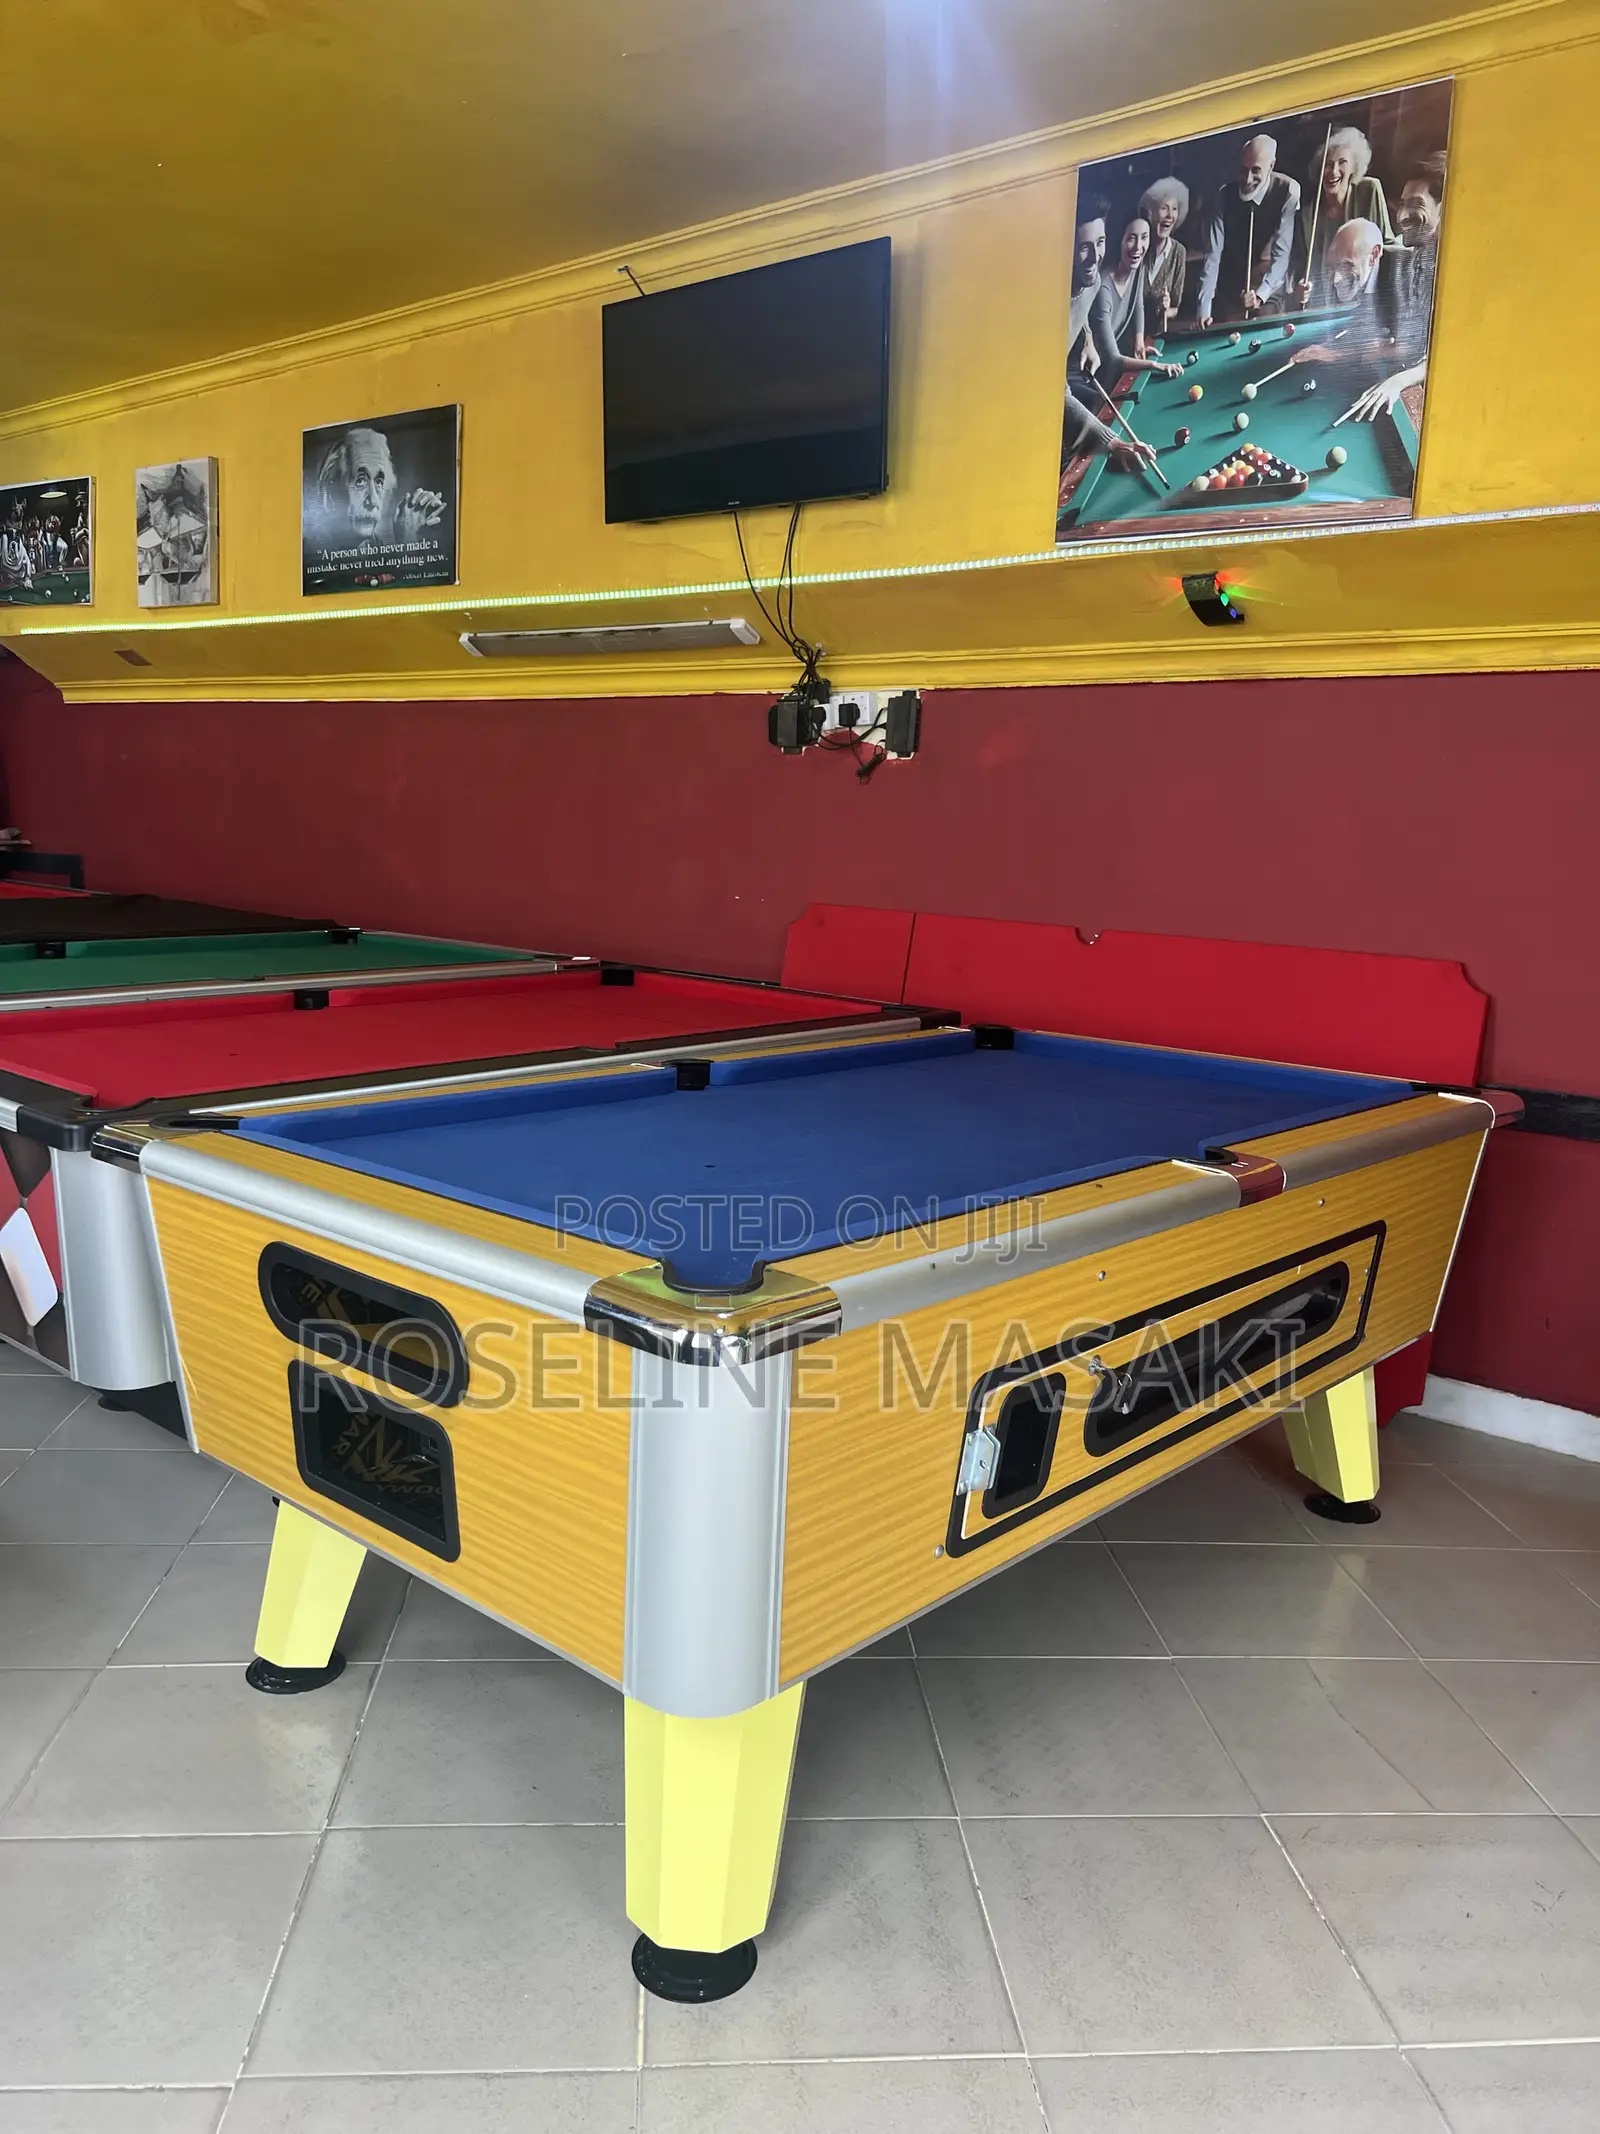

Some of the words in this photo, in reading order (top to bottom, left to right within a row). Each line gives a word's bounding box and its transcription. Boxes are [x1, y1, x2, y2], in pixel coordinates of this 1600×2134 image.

[331, 548, 358, 561] person
[359, 543, 378, 555] who
[380, 544, 404, 554] never
[406, 538, 431, 551] made
[432, 540, 438, 549] a
[306, 562, 339, 574] mistake
[339, 561, 362, 571] never
[364, 557, 384, 567] tried
[386, 554, 425, 568] anything
